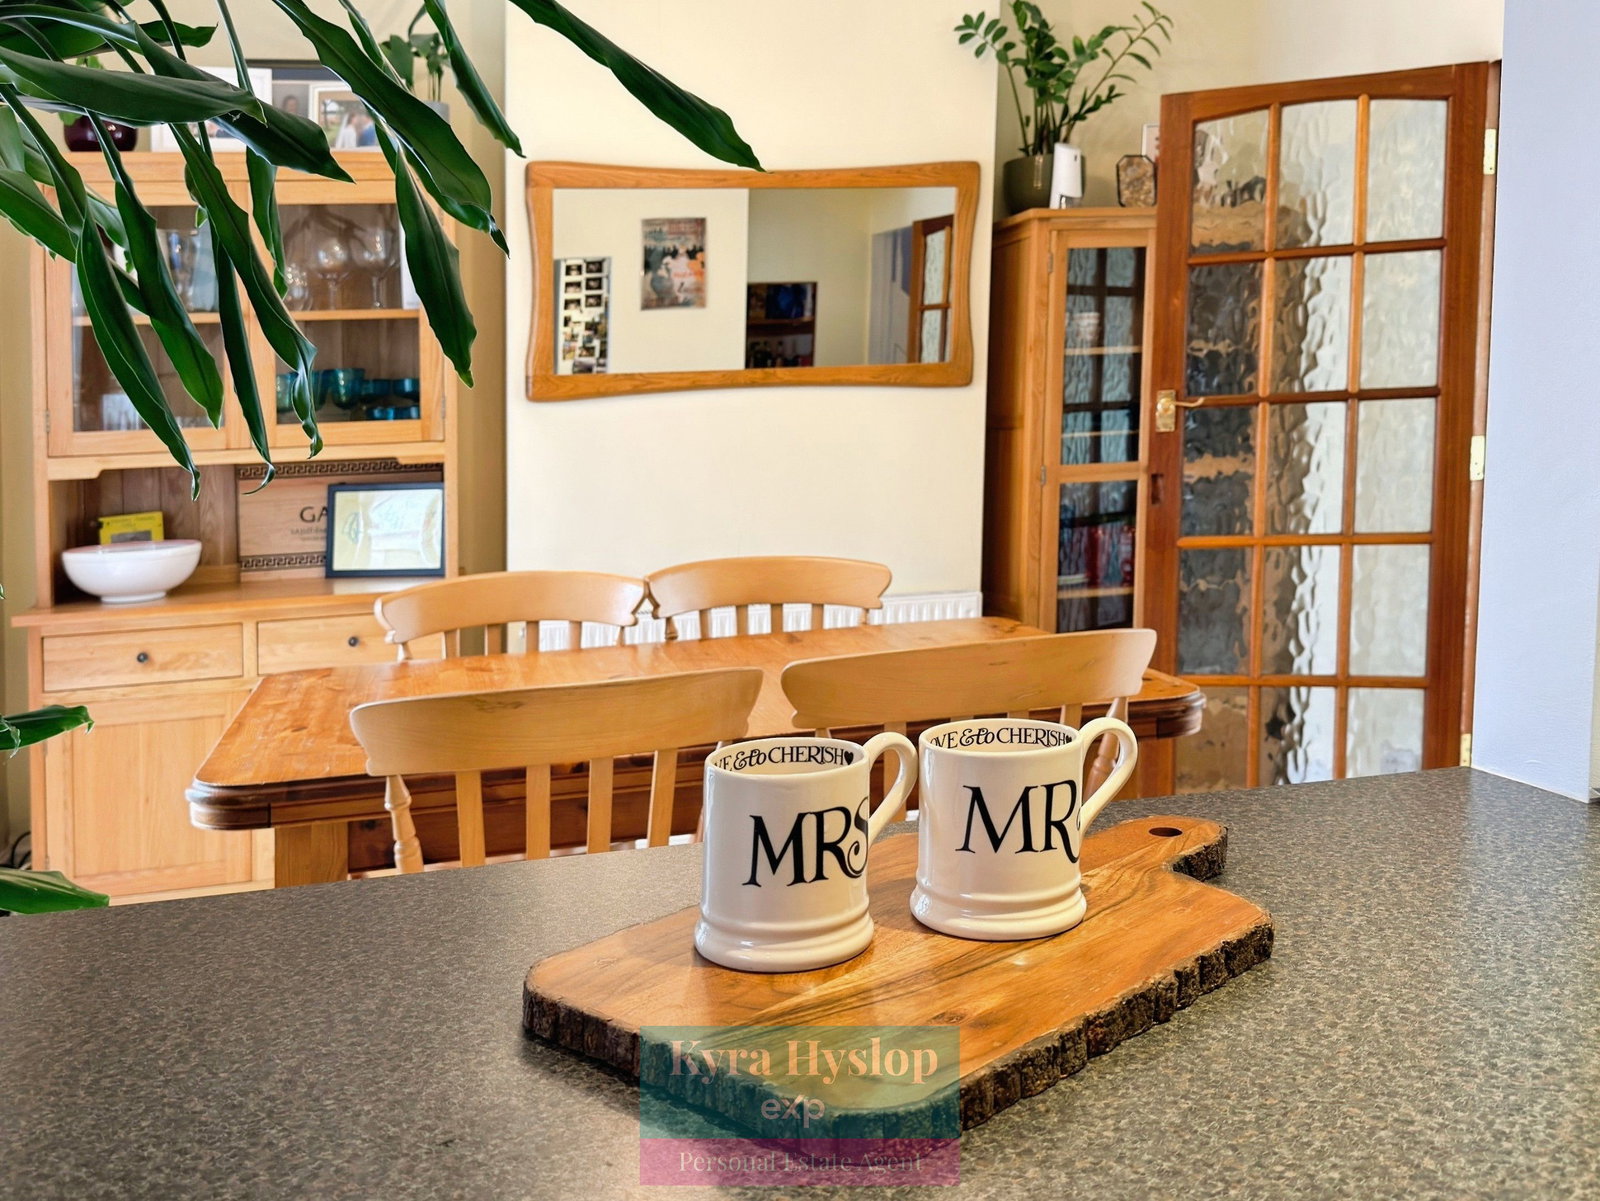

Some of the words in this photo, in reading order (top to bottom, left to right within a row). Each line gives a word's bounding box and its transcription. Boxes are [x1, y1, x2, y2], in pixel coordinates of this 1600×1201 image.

[768, 745, 844, 766] CHERISH
[996, 727, 1066, 748] CHERISH
[741, 796, 869, 888] MRS
[955, 779, 1080, 864] MR
